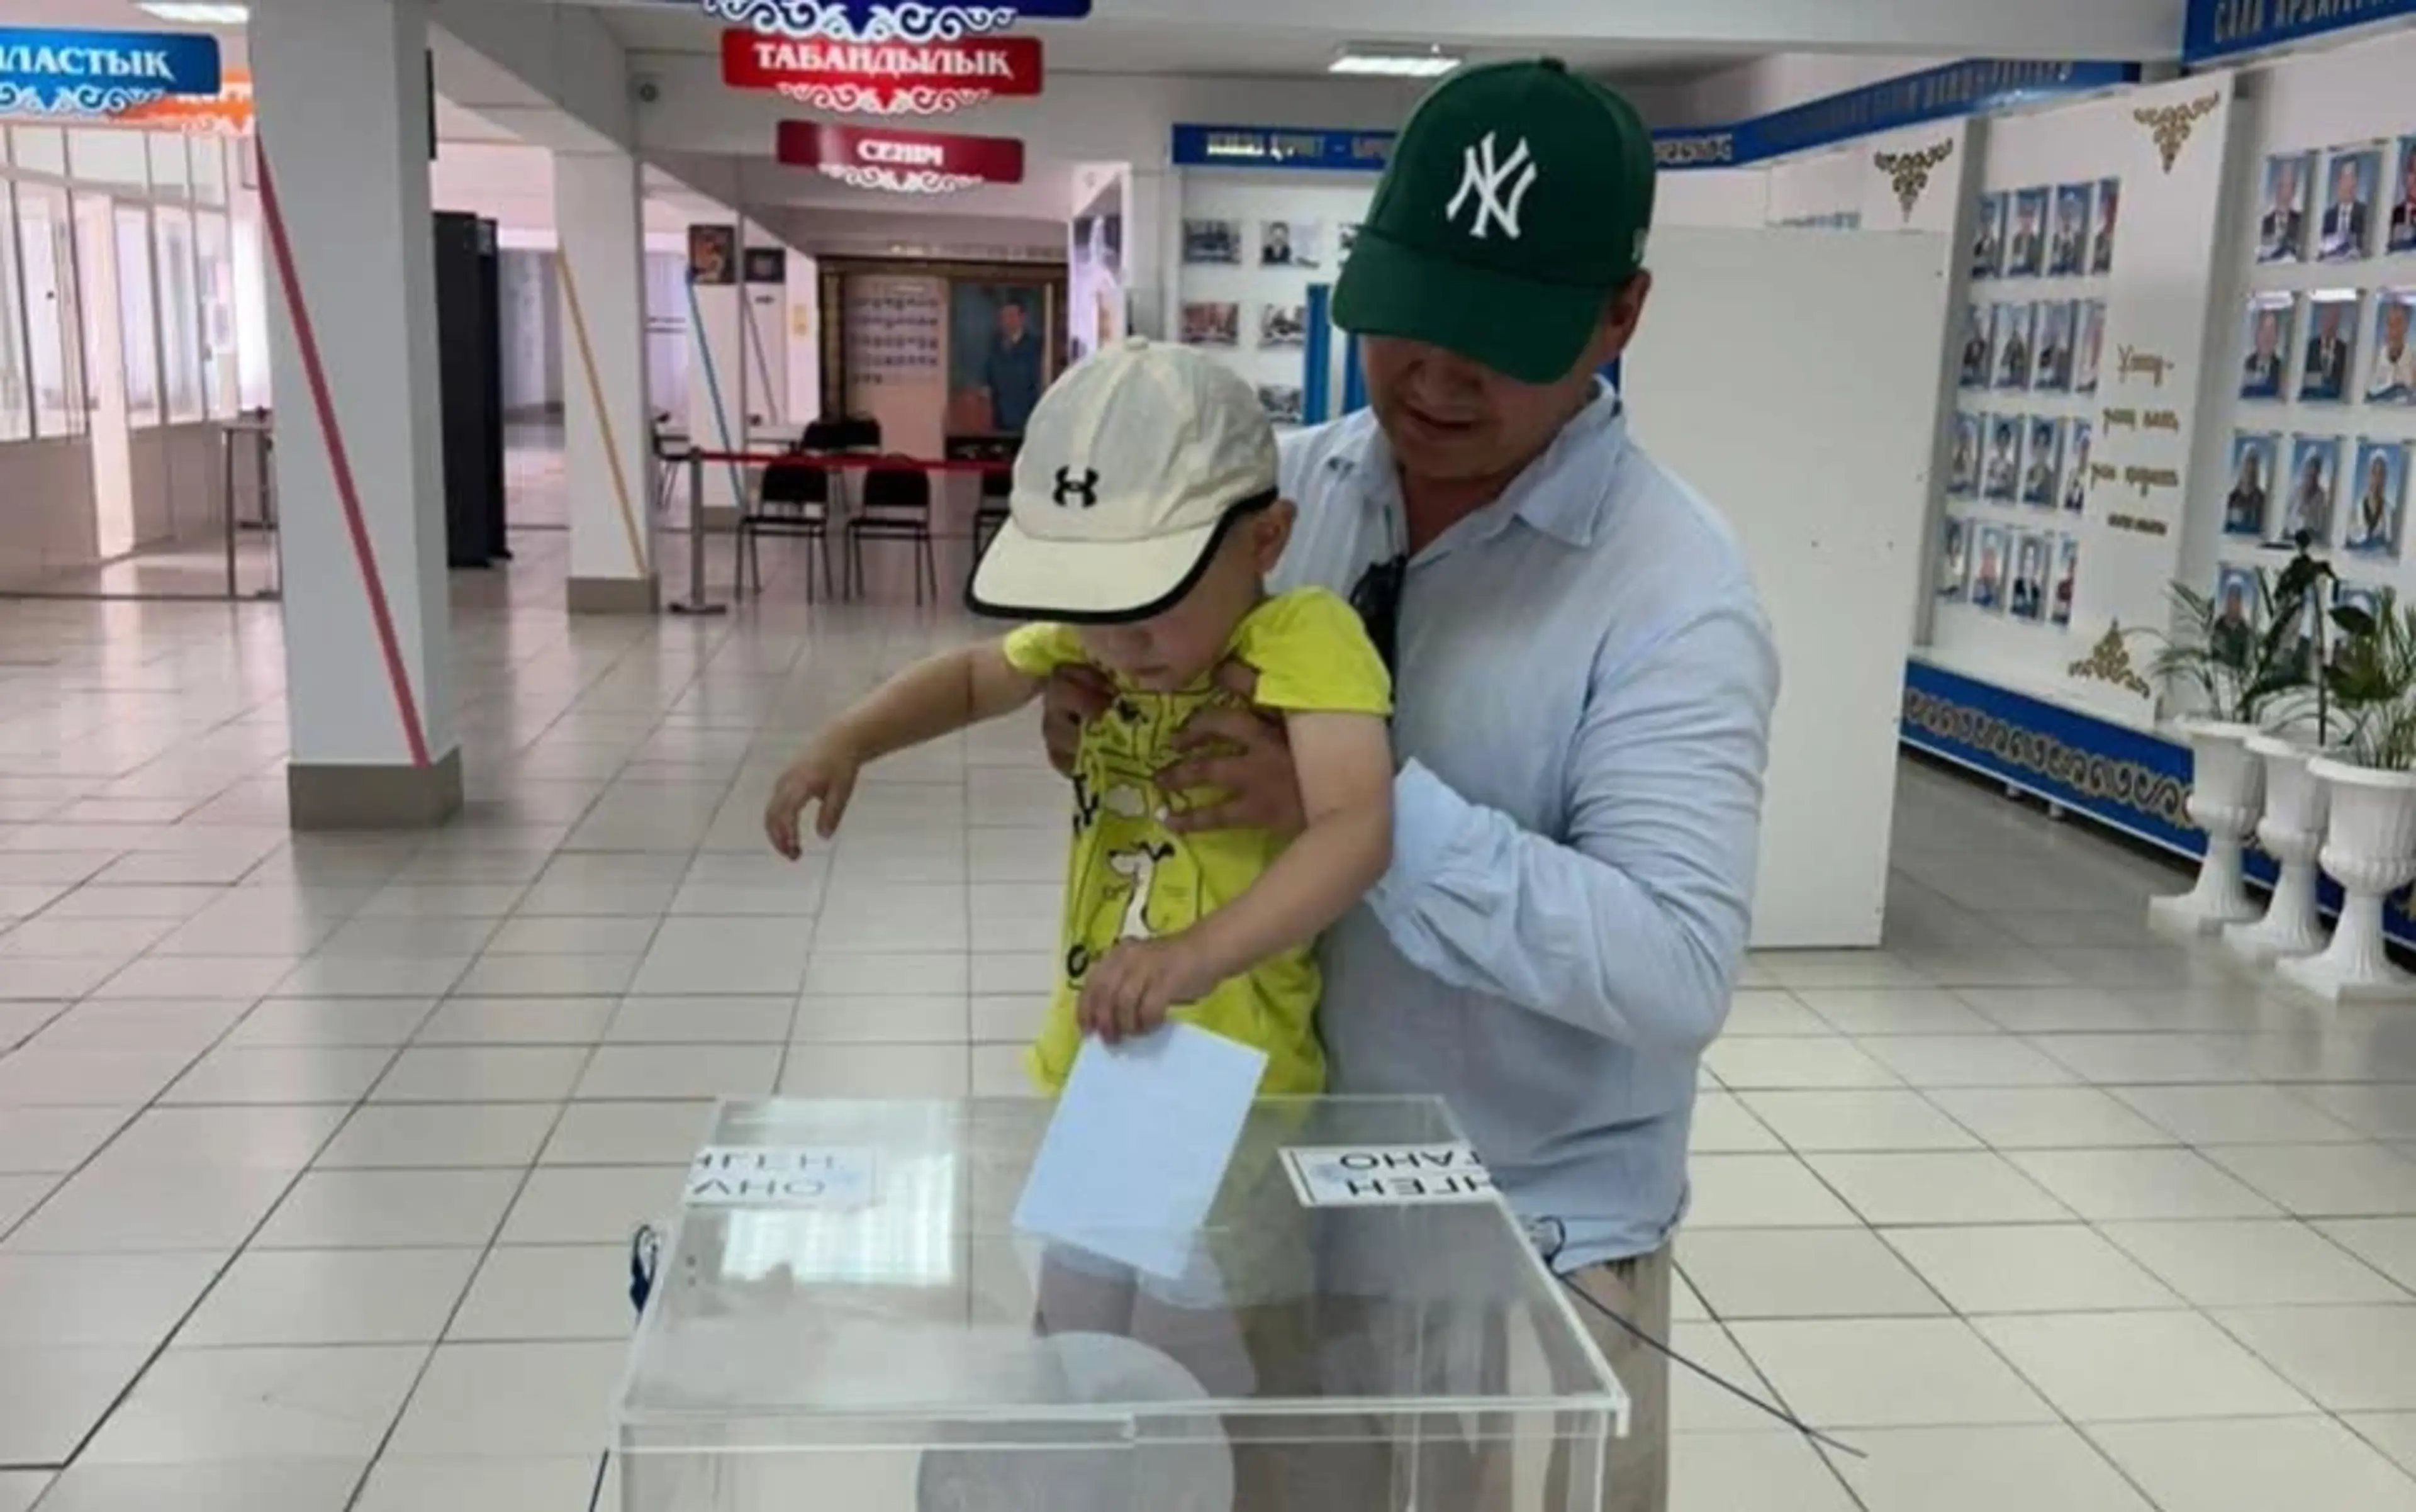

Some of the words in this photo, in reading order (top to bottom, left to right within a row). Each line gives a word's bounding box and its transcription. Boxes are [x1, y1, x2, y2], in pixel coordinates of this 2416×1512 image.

[0, 44, 177, 82] ЛАСТЫҚ
[753, 42, 1015, 79] ТАБАНДЫЛЫҚ
[1445, 130, 1537, 239] NY
